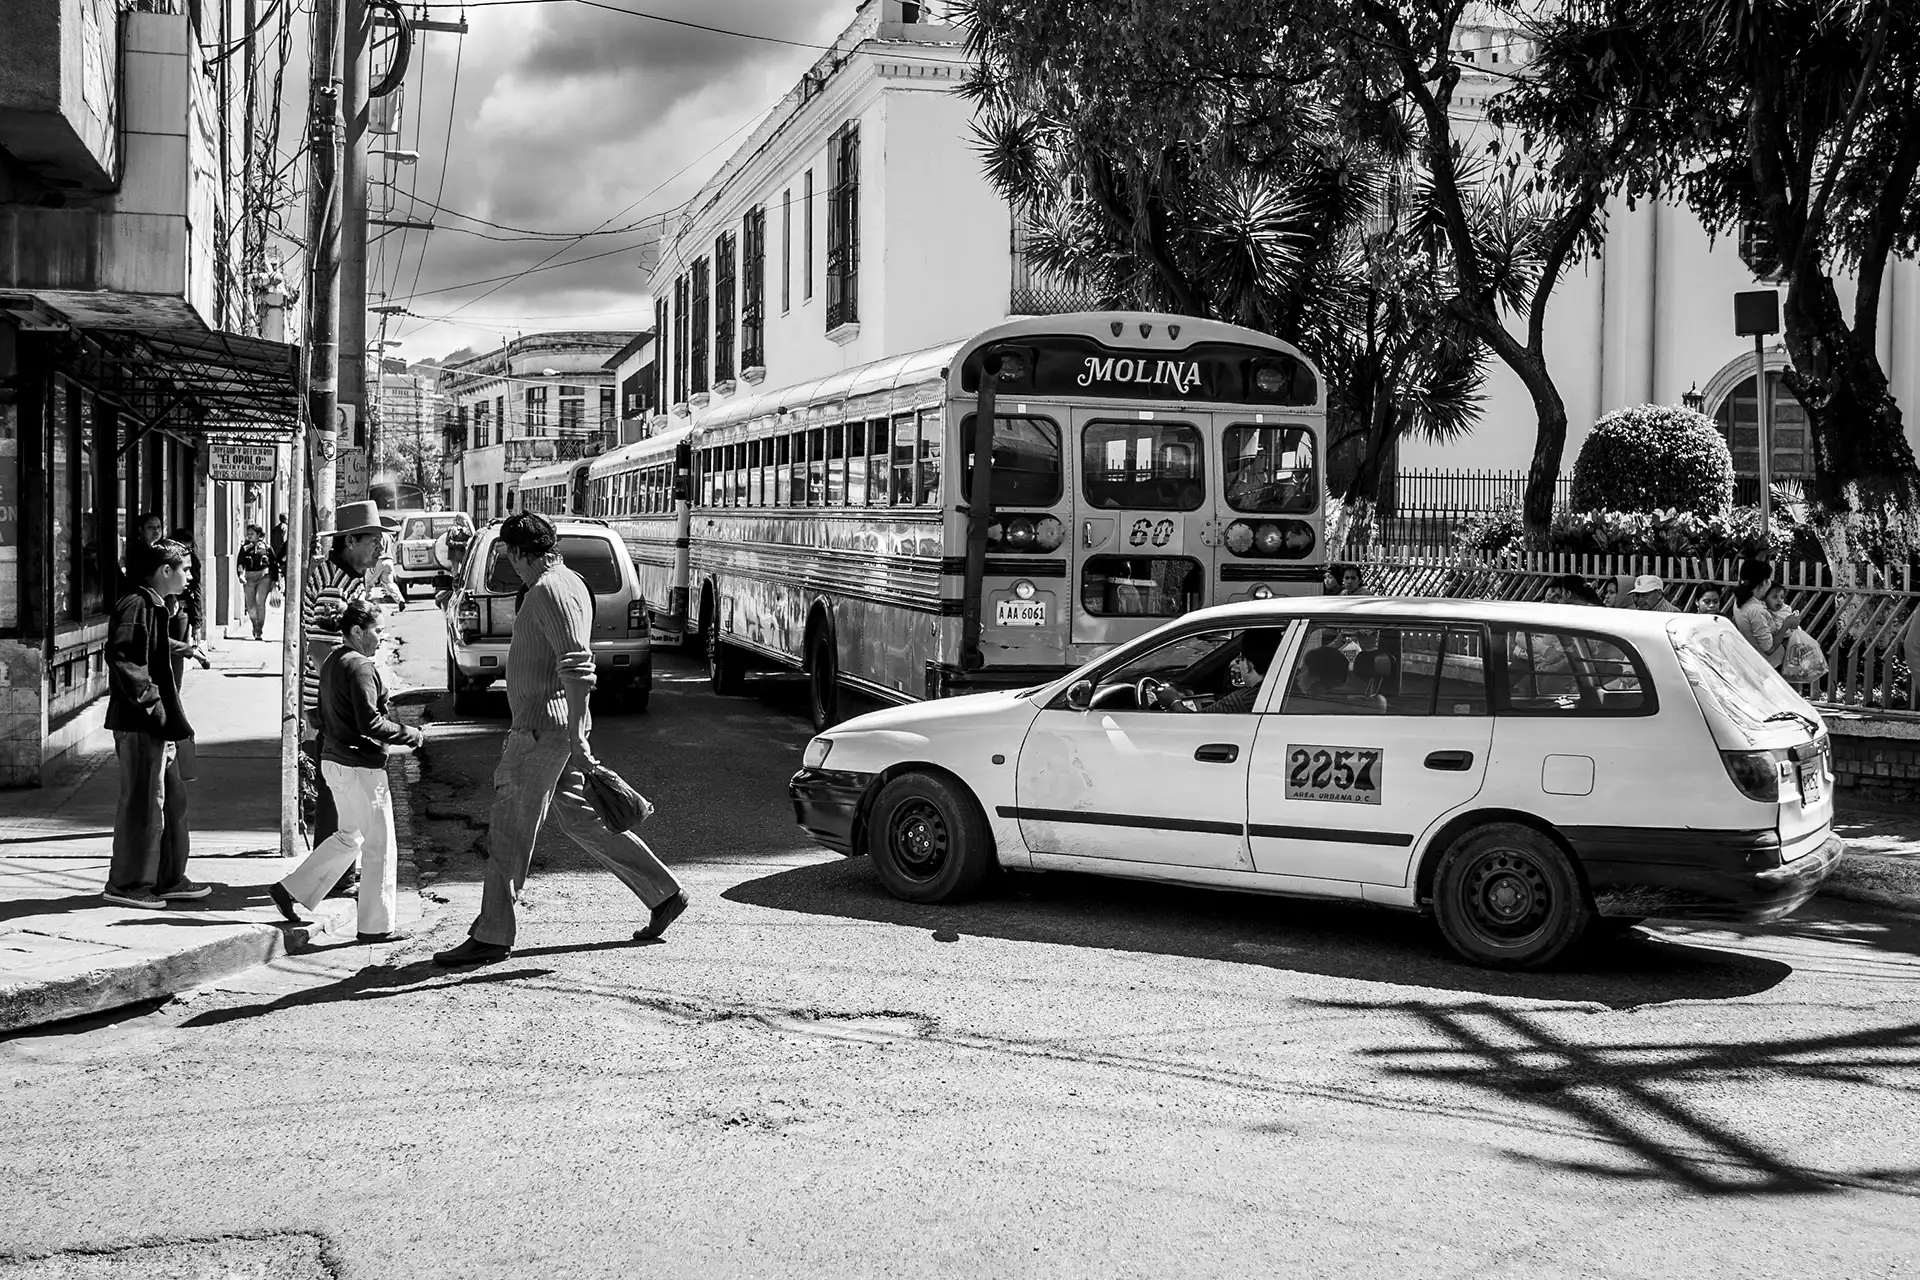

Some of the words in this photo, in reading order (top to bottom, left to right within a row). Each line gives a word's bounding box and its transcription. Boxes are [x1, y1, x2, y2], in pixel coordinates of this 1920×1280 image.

[1077, 357, 1202, 394] MOLINA
[1129, 518, 1175, 547] 60
[1022, 607, 1044, 620] 6061
[1290, 748, 1379, 791] 2257
[1293, 791, 1315, 799] AREA
[1319, 792, 1353, 801] URBANA
